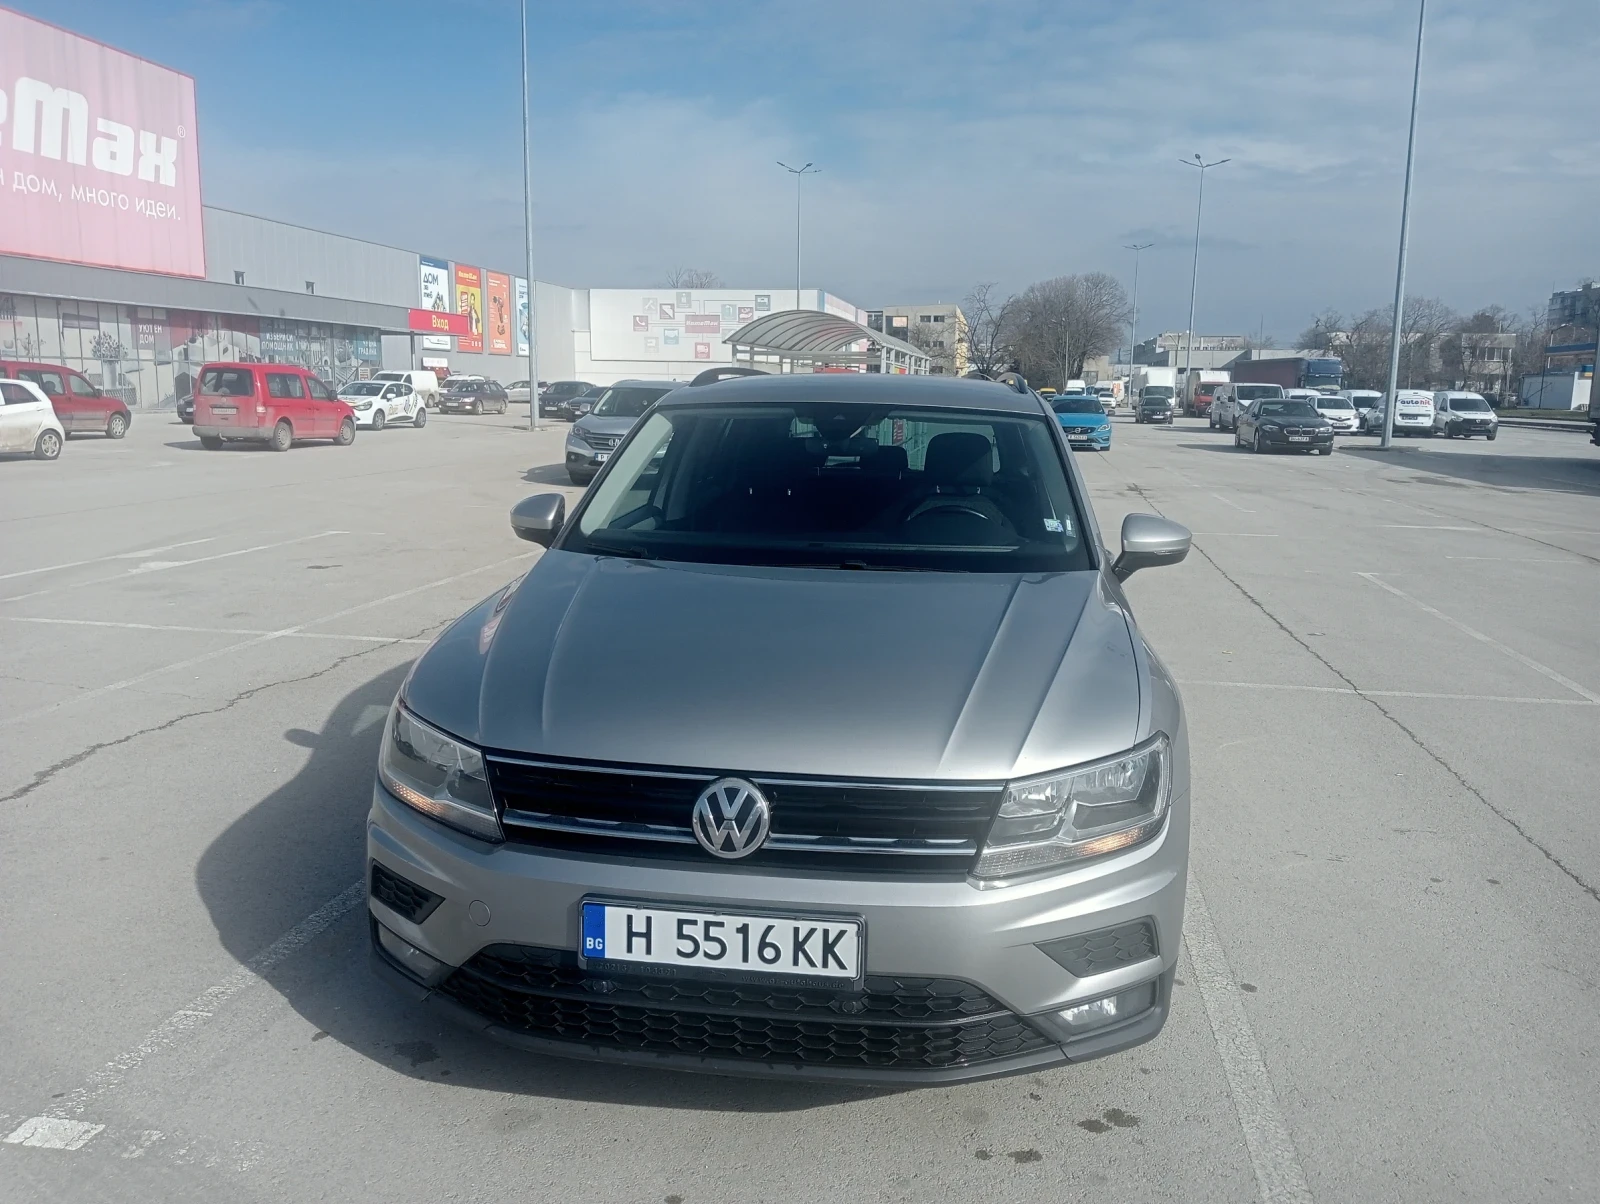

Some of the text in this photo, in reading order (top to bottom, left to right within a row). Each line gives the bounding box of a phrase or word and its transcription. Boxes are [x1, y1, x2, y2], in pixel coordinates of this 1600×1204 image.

[71, 183, 130, 211] много
[135, 196, 182, 221] идеи.
[432, 314, 449, 331] Вход
[139, 334, 155, 345] ДОМ
[586, 938, 603, 950] BG
[626, 914, 849, 971] H 5516 KK
